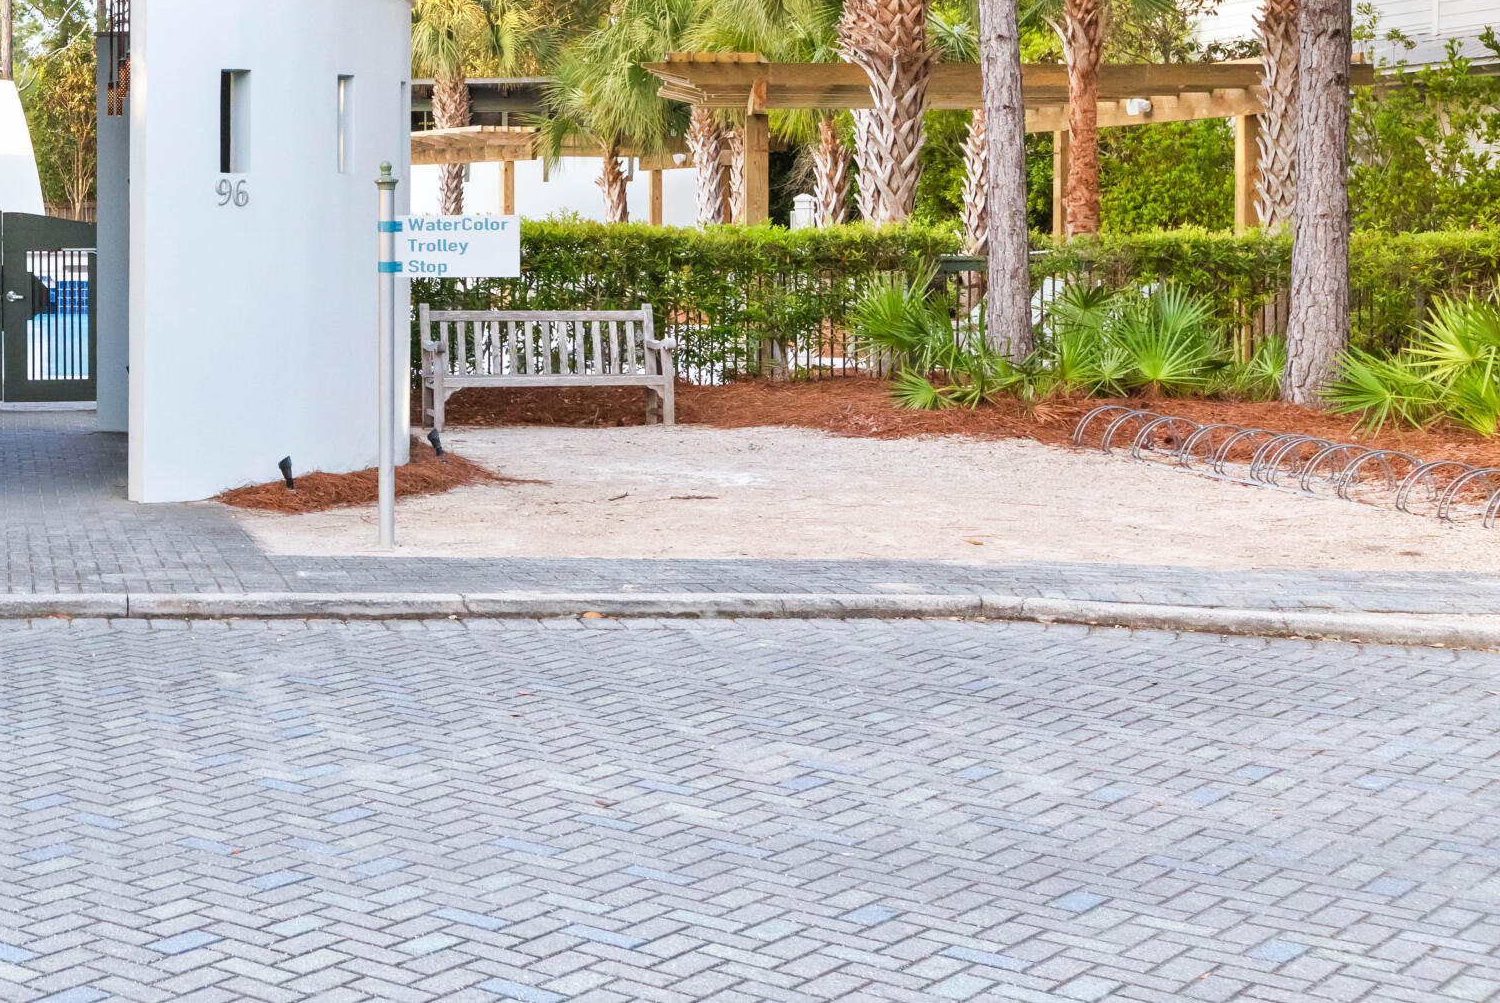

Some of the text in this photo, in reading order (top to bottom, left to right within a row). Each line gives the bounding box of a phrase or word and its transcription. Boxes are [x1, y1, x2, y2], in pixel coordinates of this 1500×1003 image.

[215, 178, 249, 207] 96
[408, 218, 509, 232] WaterColor
[408, 239, 469, 255] Trolley
[408, 260, 448, 276] Stop
